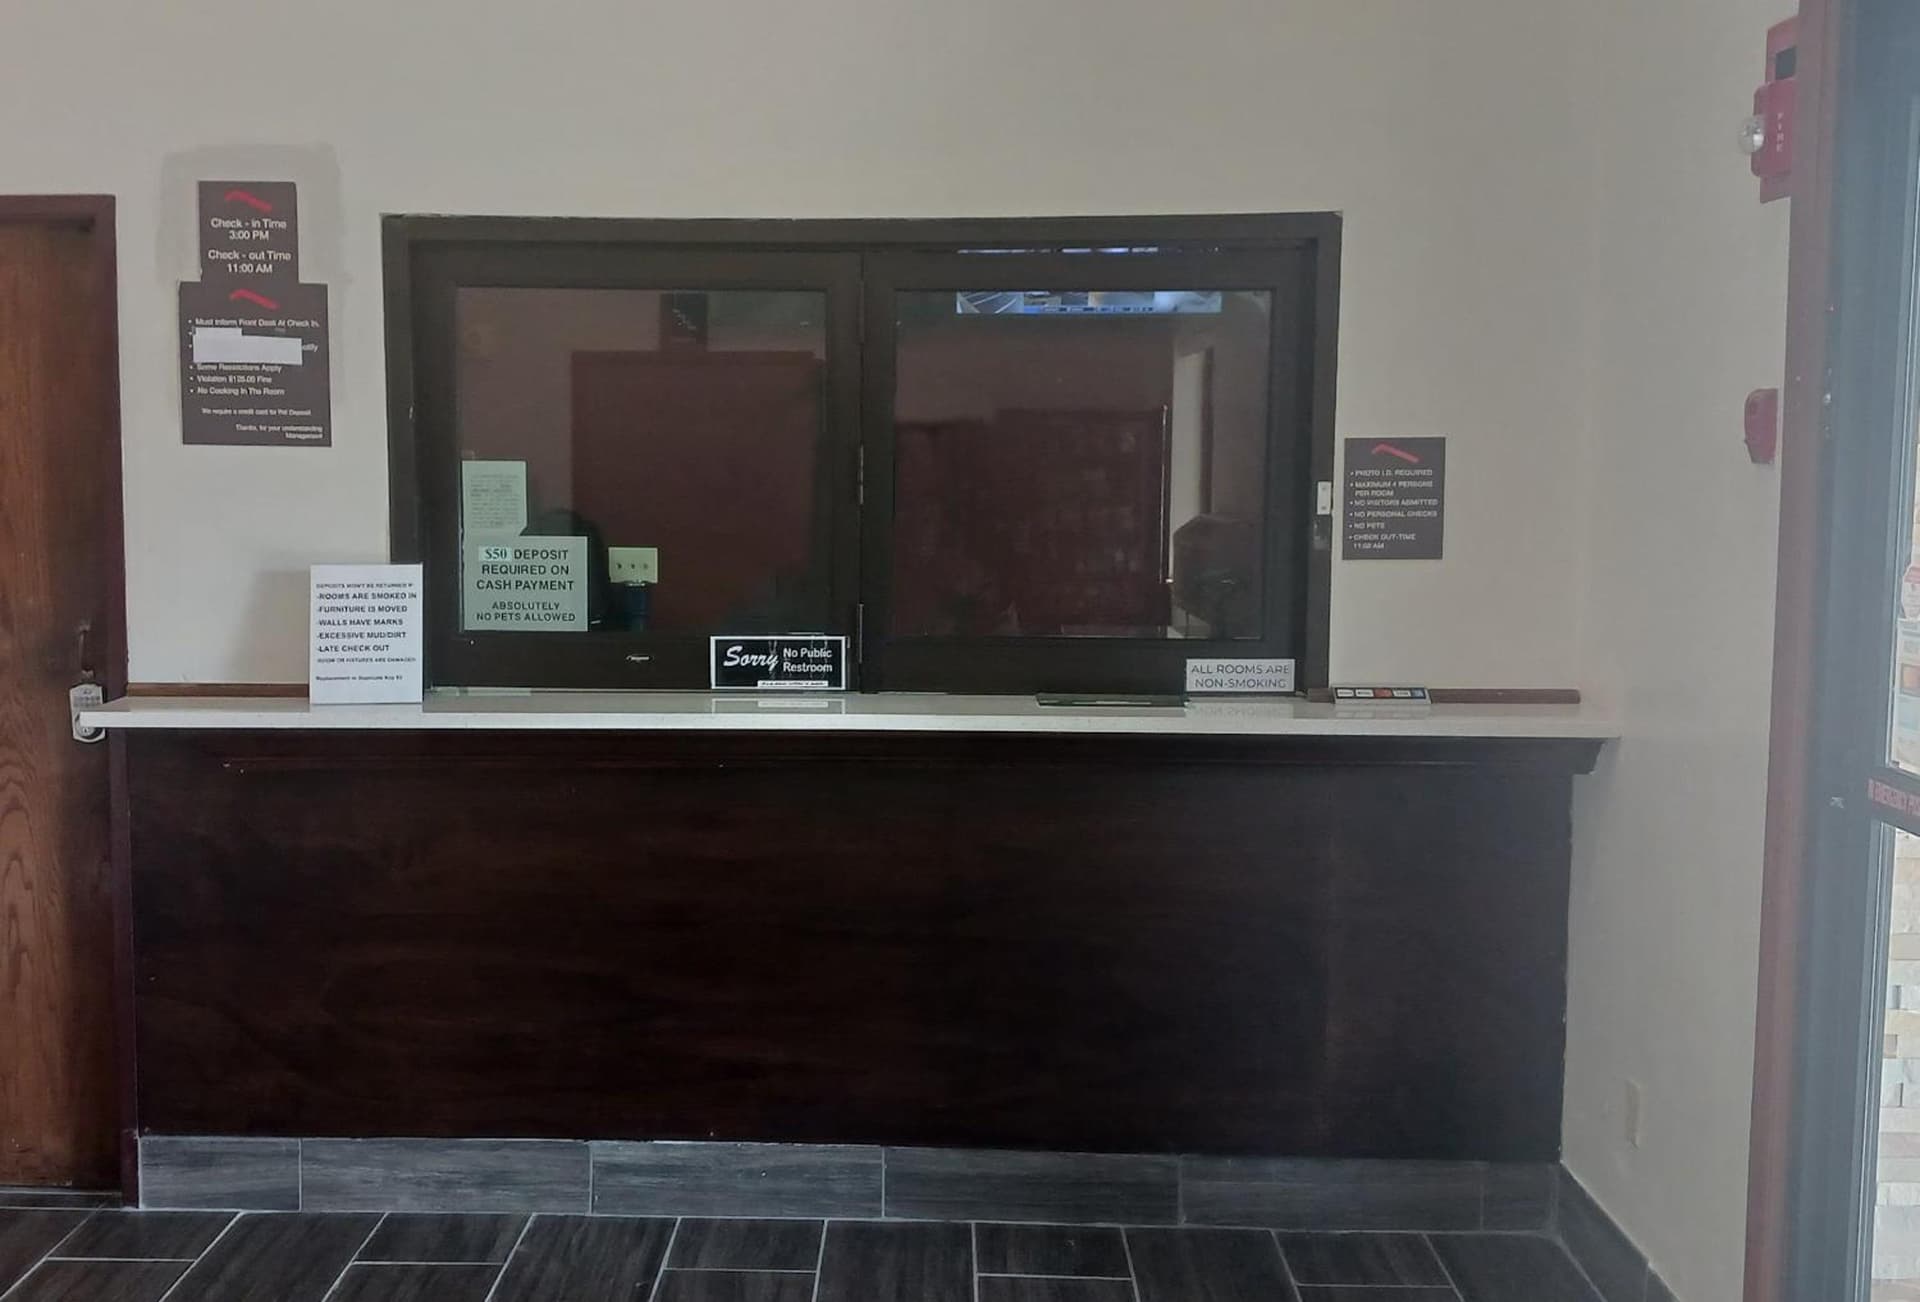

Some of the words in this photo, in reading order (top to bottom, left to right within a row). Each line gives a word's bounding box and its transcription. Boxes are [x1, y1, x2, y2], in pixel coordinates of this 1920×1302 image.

[1776, 112, 1784, 152] FIRE
[210, 217, 242, 229] Check
[251, 218, 261, 229] in
[263, 218, 287, 230] Time
[228, 230, 250, 241] 3:00
[252, 230, 270, 241] PM
[208, 249, 240, 261] Check
[248, 250, 265, 261] out
[267, 250, 292, 262] Time
[227, 263, 254, 273] 11:00
[255, 263, 273, 273] AM
[195, 318, 214, 327] Must
[215, 318, 238, 327] Inform
[239, 318, 257, 328] Front
[258, 318, 276, 328] Desk
[277, 319, 286, 328] At
[287, 319, 309, 328] Check
[197, 363, 217, 372] Some
[218, 363, 260, 373] Restrictions
[261, 364, 282, 375] Apply
[197, 375, 227, 384] Violation
[257, 375, 273, 384] Fine
[197, 386, 208, 395] No
[209, 386, 239, 397] Cooking
[240, 387, 248, 396] In
[249, 387, 261, 396] The
[262, 387, 285, 397] Room
[1354, 468, 1380, 477] PHOTO
[1354, 489, 1369, 497] PER
[1370, 489, 1394, 497] ROOM
[1354, 499, 1366, 507] NO
[1353, 522, 1366, 530] NO
[1366, 521, 1385, 530] PETS
[1353, 533, 1379, 541] CHECK
[485, 548, 508, 560] $50
[513, 548, 569, 561] DEPOSIT
[481, 564, 546, 576] REQUIRED
[550, 564, 570, 576] ON
[476, 579, 512, 591] CASH
[514, 579, 575, 591] PAYMENT
[317, 592, 350, 601] -ROOMS
[351, 592, 369, 600] ARE
[371, 592, 407, 600] SMOKED
[408, 592, 417, 600] IN
[317, 605, 366, 613] -FURNITURE
[367, 605, 376, 613] IS
[377, 605, 408, 613] MOVED
[491, 600, 561, 612] ABSOLUTELY
[476, 612, 492, 622] NO
[494, 612, 522, 622] PETS
[523, 612, 576, 622] ALLOWED
[318, 618, 348, 627] -WALLS
[349, 618, 372, 626] HAVE
[373, 618, 403, 626] MARKS
[317, 631, 365, 640] -EXCESSIVE
[366, 631, 407, 639] MUD/DIRT
[317, 644, 340, 653] -LATE
[341, 644, 371, 652] CHECK
[372, 644, 390, 652] OUT
[722, 645, 780, 673] Sorry
[782, 647, 798, 659] No
[800, 647, 833, 659] Public
[782, 661, 833, 673] Restroom
[1191, 664, 1213, 675] ALL
[1215, 664, 1263, 675] ROOMS
[1264, 664, 1290, 674] ARE
[1194, 677, 1288, 689] NON-SMOKING
